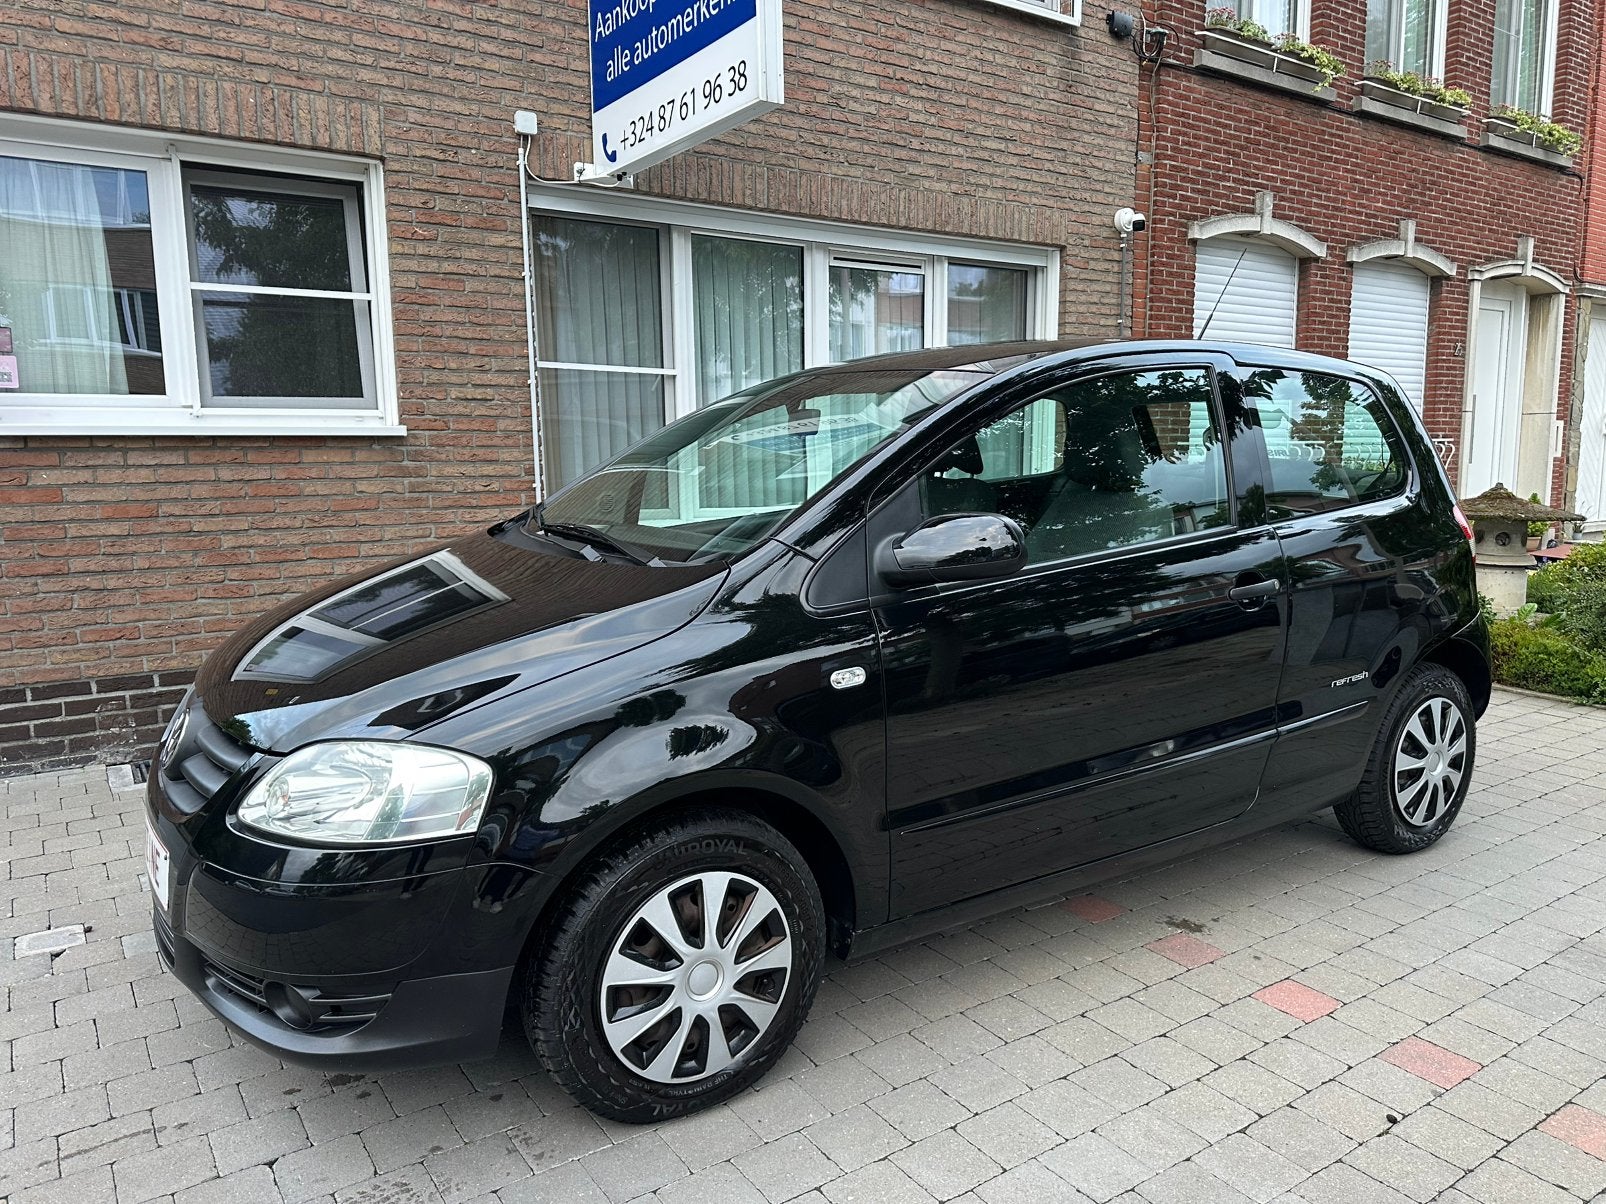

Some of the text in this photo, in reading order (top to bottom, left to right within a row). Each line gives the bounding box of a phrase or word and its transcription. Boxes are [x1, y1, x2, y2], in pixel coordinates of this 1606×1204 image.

[606, 45, 630, 82] alle
[620, 59, 748, 151] +324 87 61 96 38
